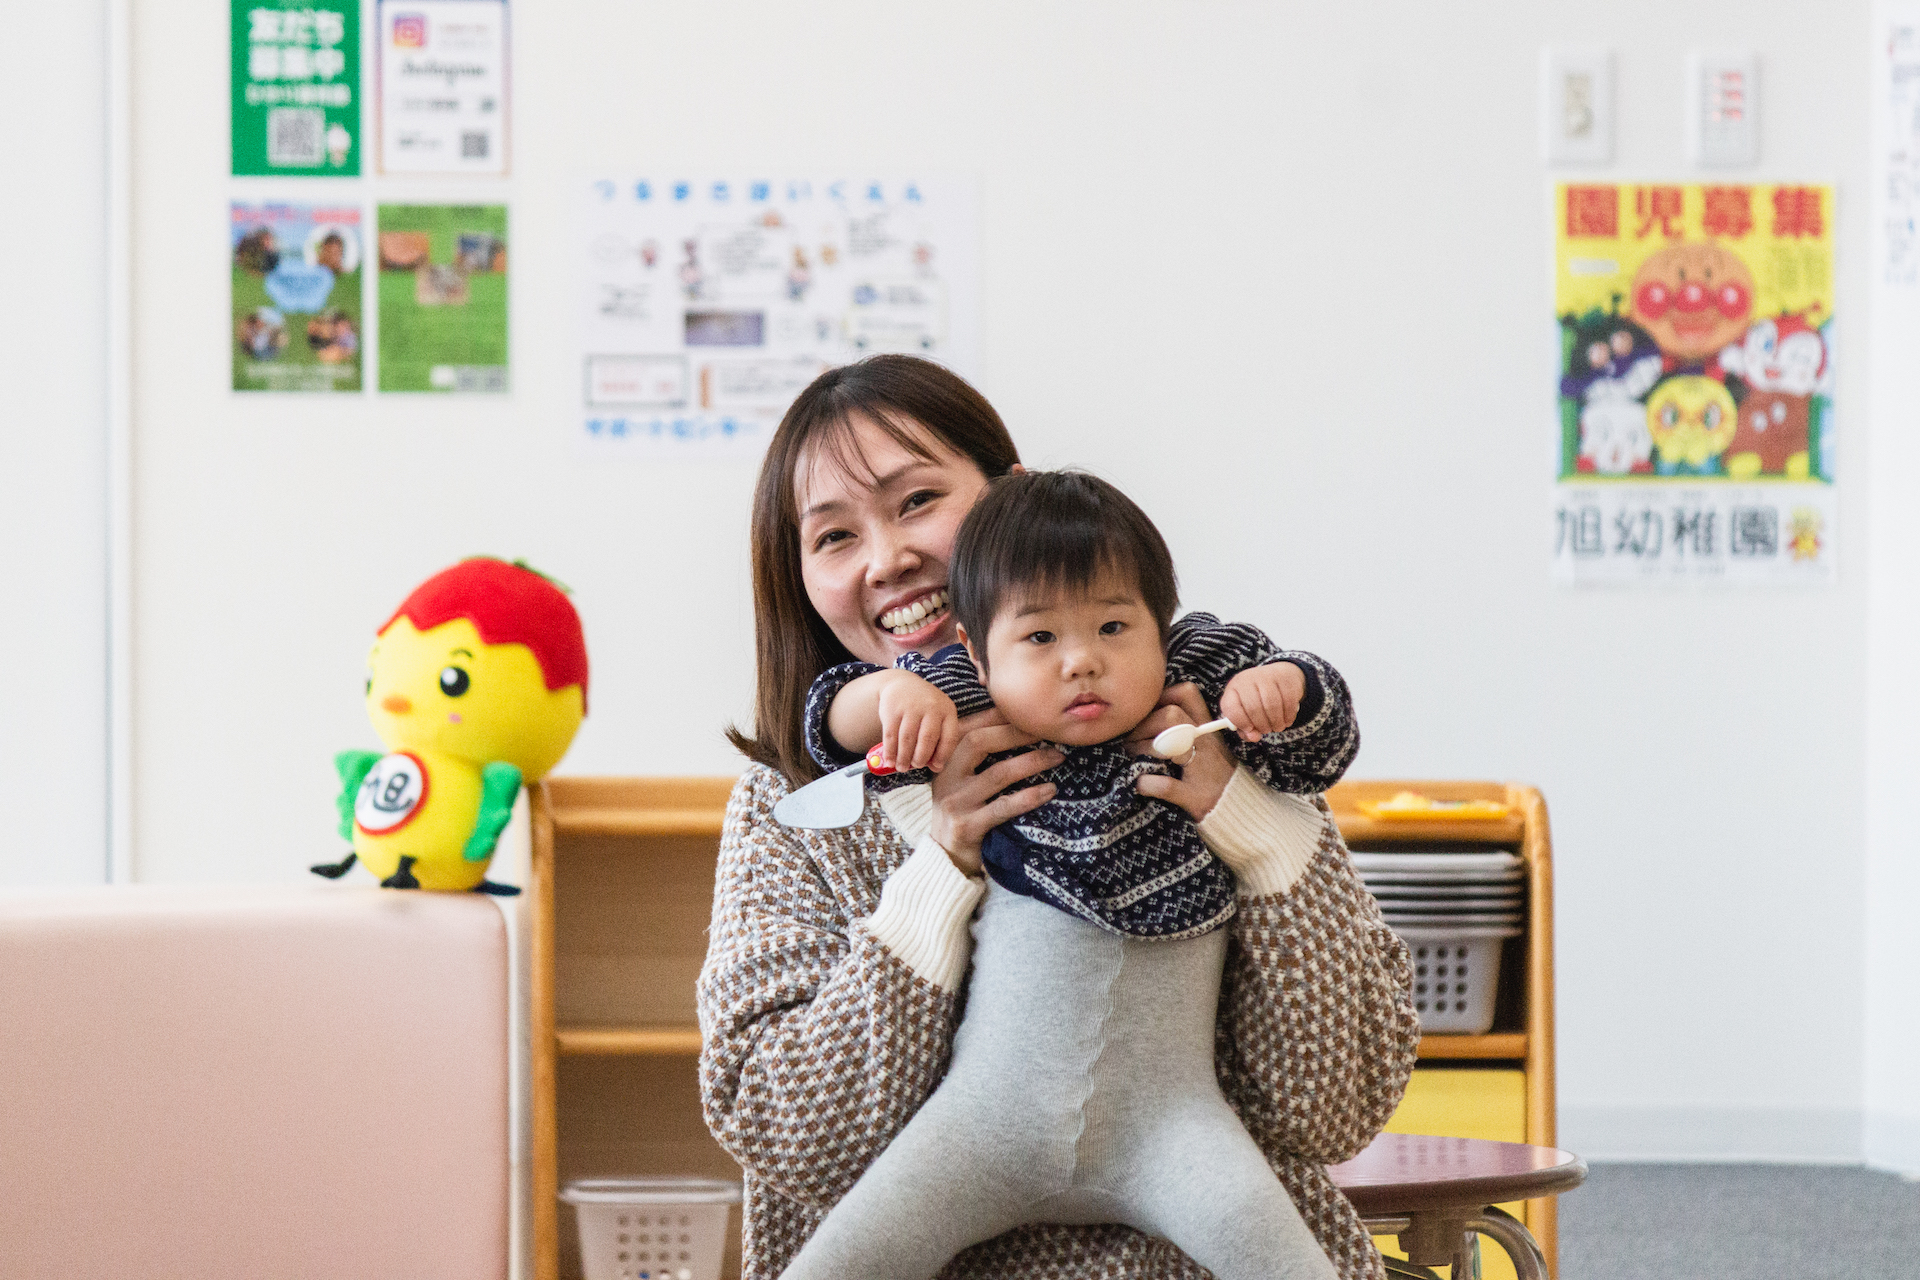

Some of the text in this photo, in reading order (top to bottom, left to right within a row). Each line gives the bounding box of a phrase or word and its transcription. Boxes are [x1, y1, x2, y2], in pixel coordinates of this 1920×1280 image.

[248, 8, 345, 44] 友だち
[1566, 185, 1823, 239] 園児募集
[1556, 505, 1779, 558] 旭幼稚園
